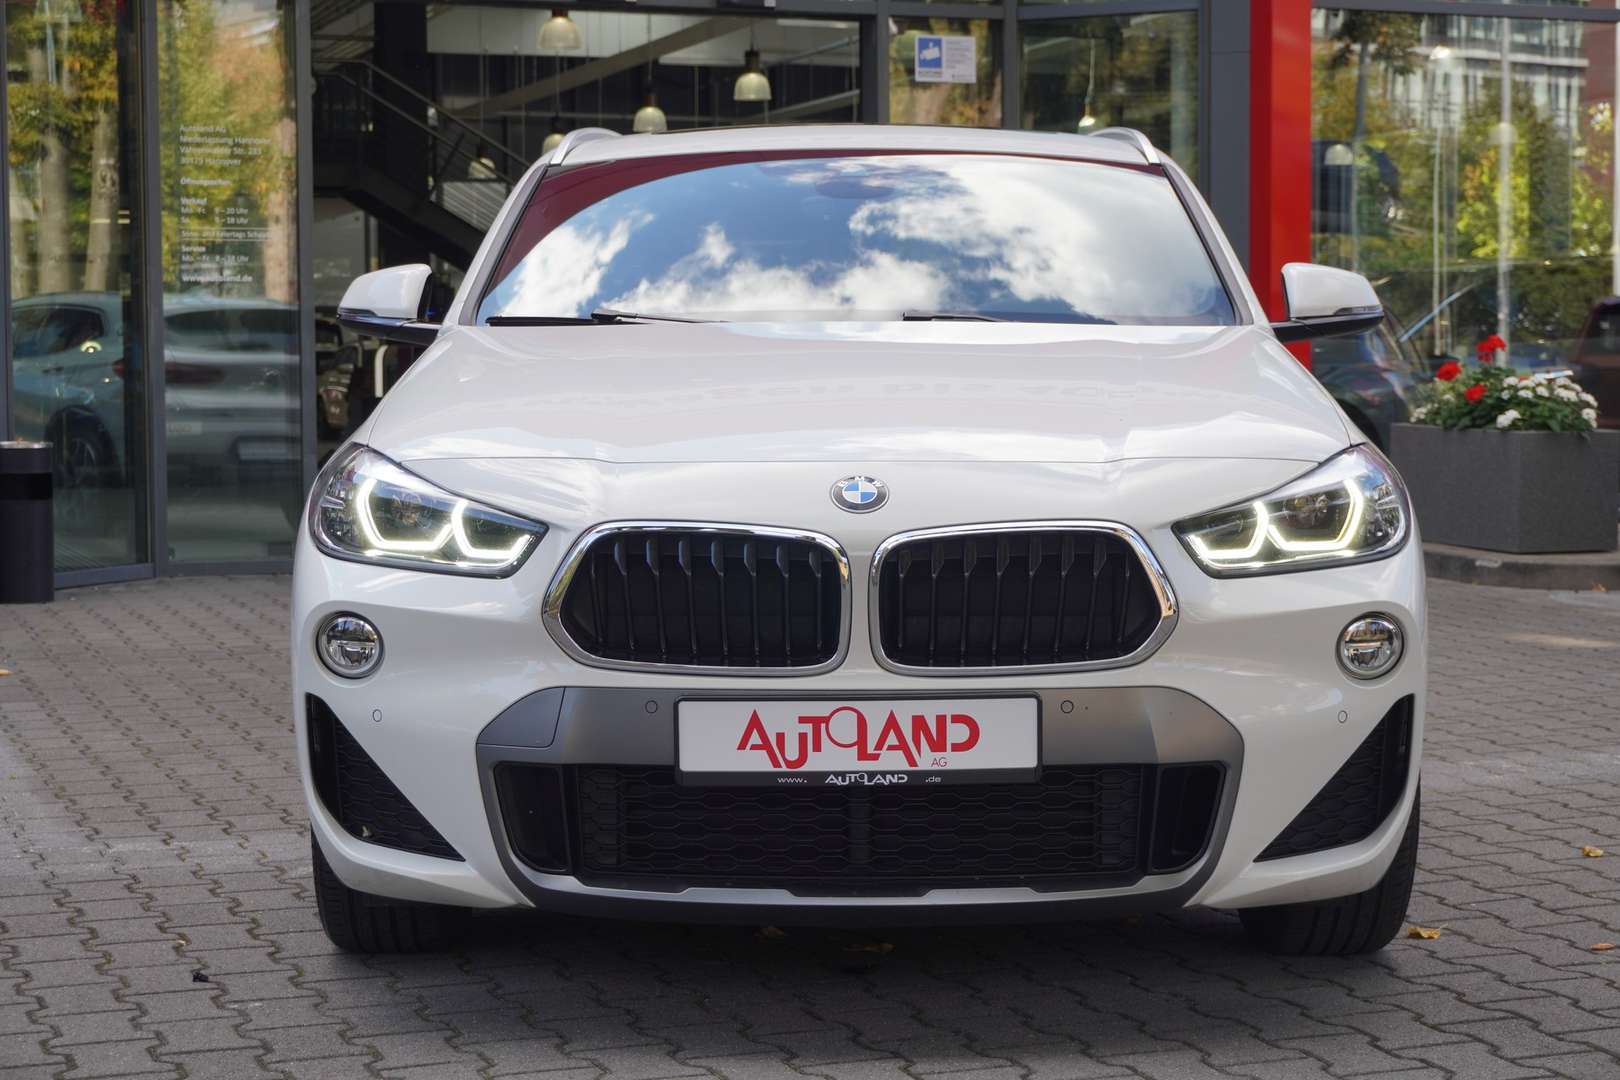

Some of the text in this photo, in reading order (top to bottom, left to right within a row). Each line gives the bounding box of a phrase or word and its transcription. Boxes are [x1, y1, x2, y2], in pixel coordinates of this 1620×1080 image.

[181, 197, 207, 205] Verkauf
[837, 475, 883, 487] BMW
[737, 706, 980, 769] AUTOLAND
[931, 757, 947, 767] AG
[825, 773, 908, 785] AUTOLAND
[925, 775, 941, 783] .de
